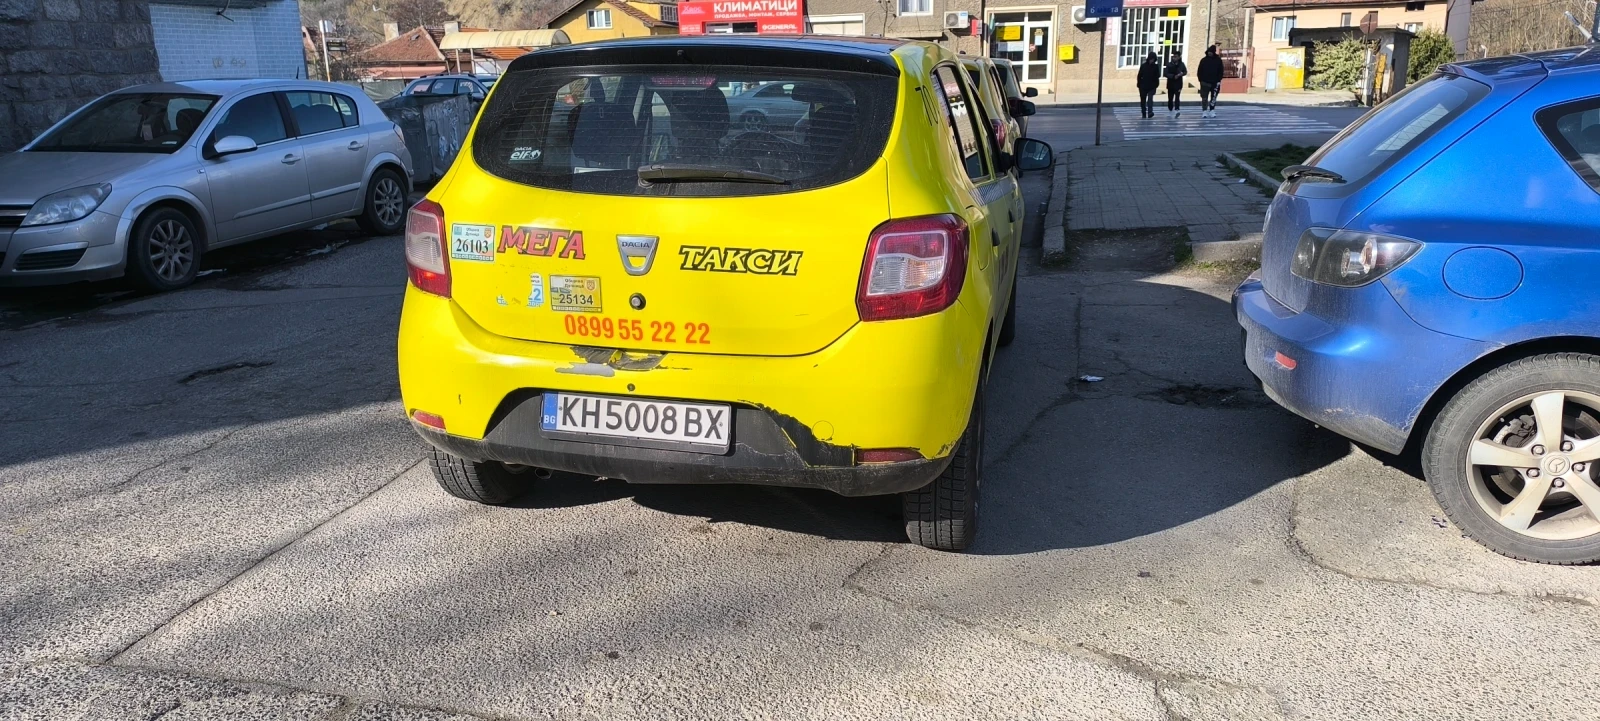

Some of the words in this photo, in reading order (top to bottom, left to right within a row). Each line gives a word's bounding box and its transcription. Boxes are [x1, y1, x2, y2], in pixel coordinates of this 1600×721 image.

[713, 1, 798, 14] КЛИМАТИЦИ
[455, 238, 489, 254] 26103
[497, 225, 586, 260] МЕГА
[621, 241, 650, 249] DACIA
[679, 245, 803, 276] ТАКСИ
[559, 293, 594, 306] 25134
[564, 314, 614, 339] 0899
[618, 319, 644, 341] 55
[650, 320, 676, 343] 22
[684, 322, 711, 344] 22
[543, 414, 556, 425] BG
